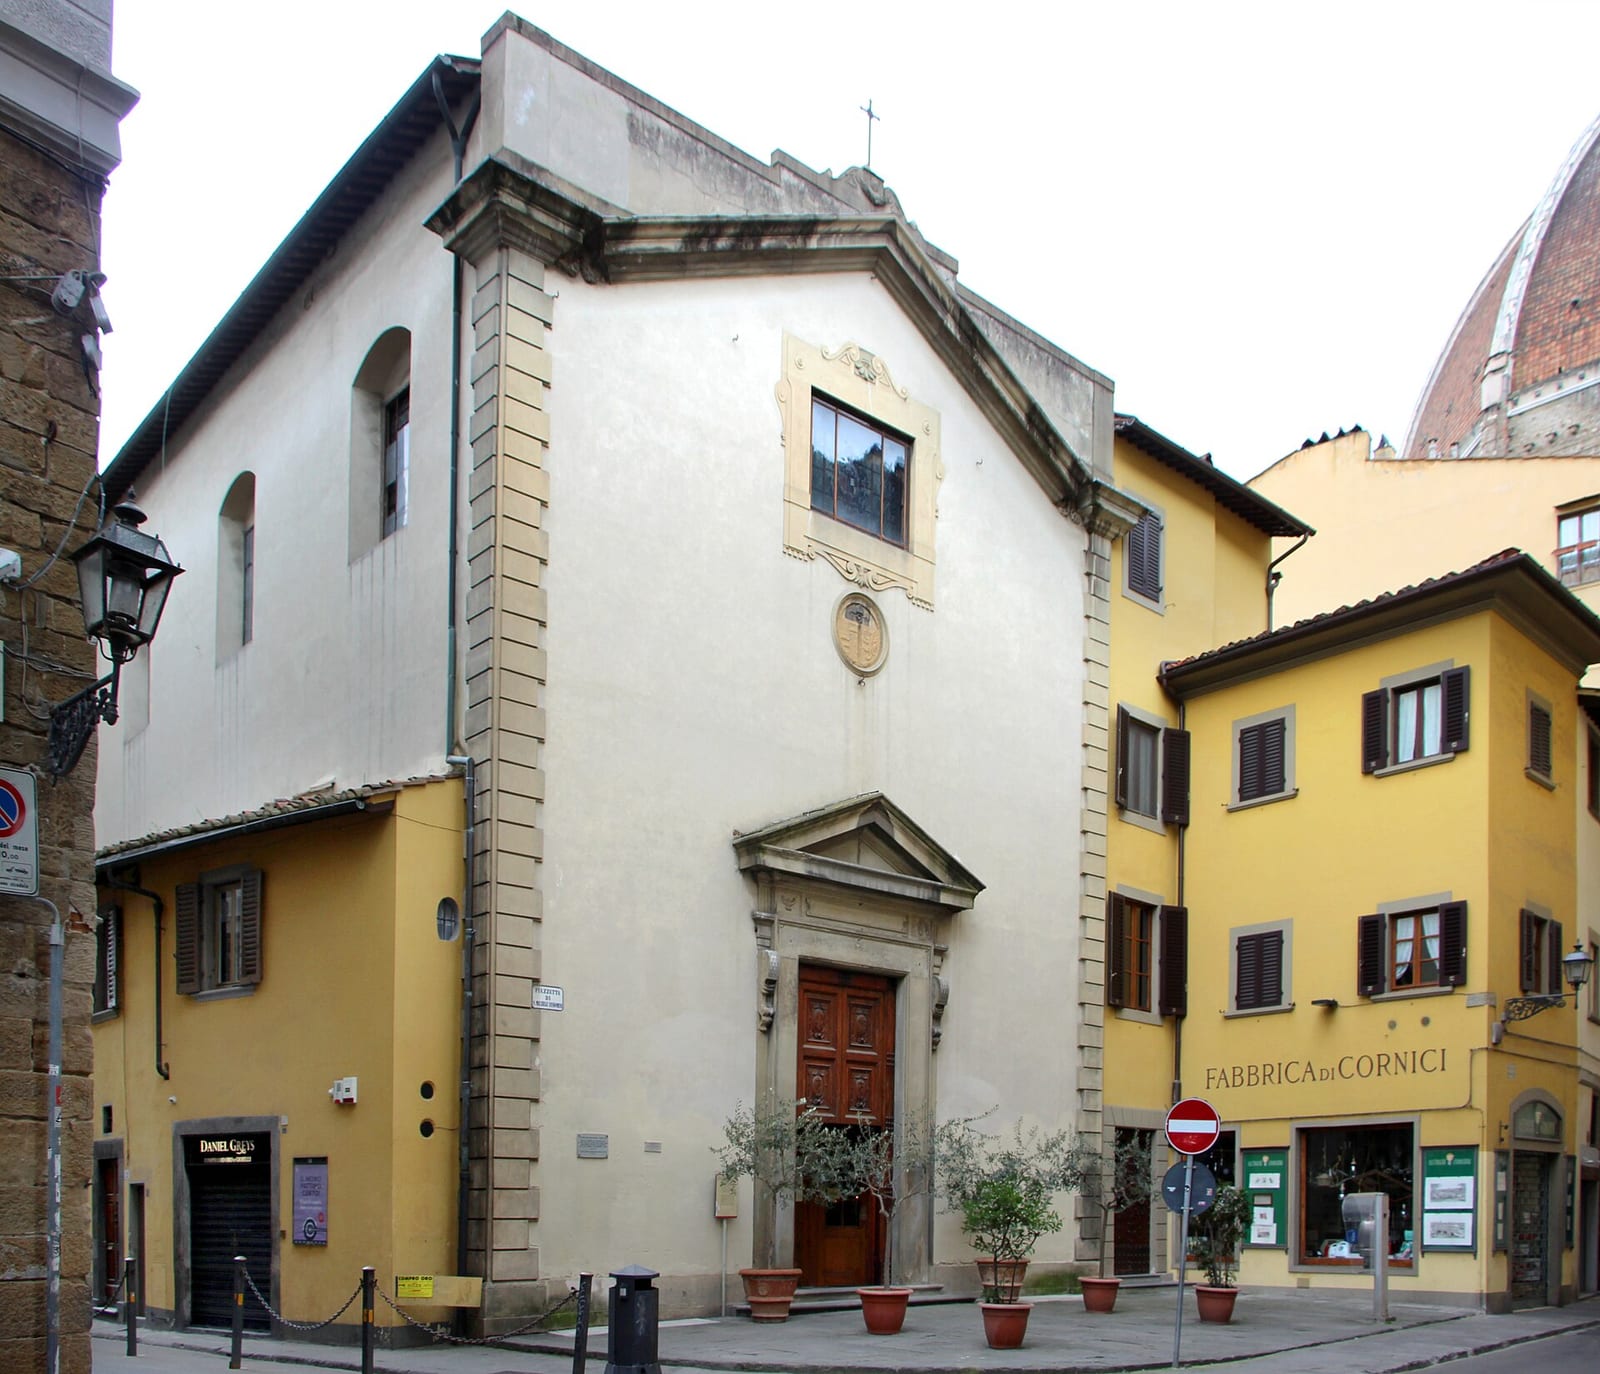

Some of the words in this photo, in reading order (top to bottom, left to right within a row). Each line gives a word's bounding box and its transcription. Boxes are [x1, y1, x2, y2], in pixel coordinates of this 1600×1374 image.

[1206, 1061, 1316, 1089] FABBRICA
[1319, 1067, 1335, 1081] DI
[1338, 1048, 1447, 1080] CORNICI
[200, 1140, 229, 1152] DANIEL
[229, 1139, 255, 1151] GREYS
